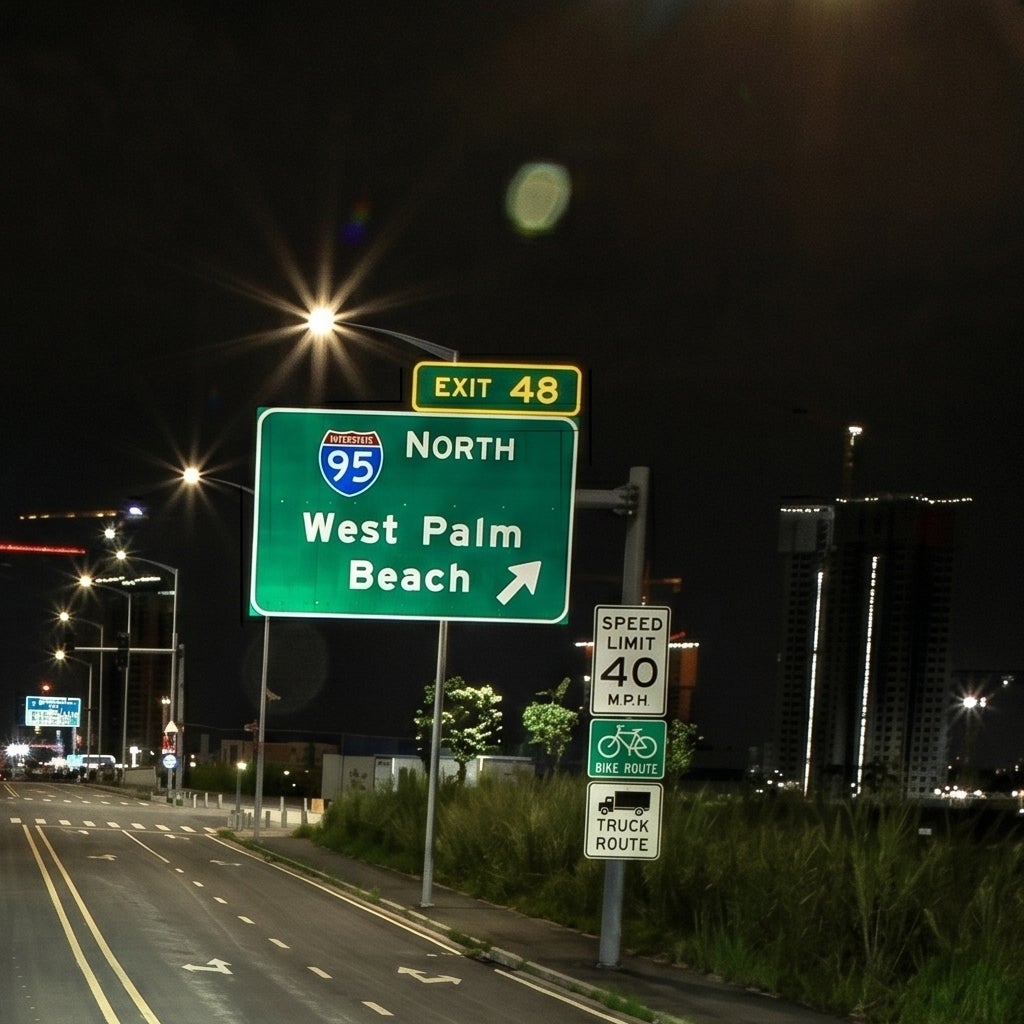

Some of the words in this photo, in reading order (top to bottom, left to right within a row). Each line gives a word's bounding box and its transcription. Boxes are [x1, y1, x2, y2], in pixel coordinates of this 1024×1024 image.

[435, 376, 492, 398] EXIT
[509, 375, 559, 405] 48
[406, 430, 515, 461] NORTH
[327, 449, 374, 483] 95
[302, 511, 398, 545] West
[422, 515, 522, 549] Palm
[349, 559, 470, 593] Beach
[602, 616, 663, 631] SPEED
[607, 636, 656, 651] LIMIT
[600, 656, 658, 688] 40
[595, 762, 619, 774] BIKE
[624, 762, 658, 775] ROUTE
[596, 818, 649, 833] TRUCK
[596, 836, 649, 852] ROUTE
